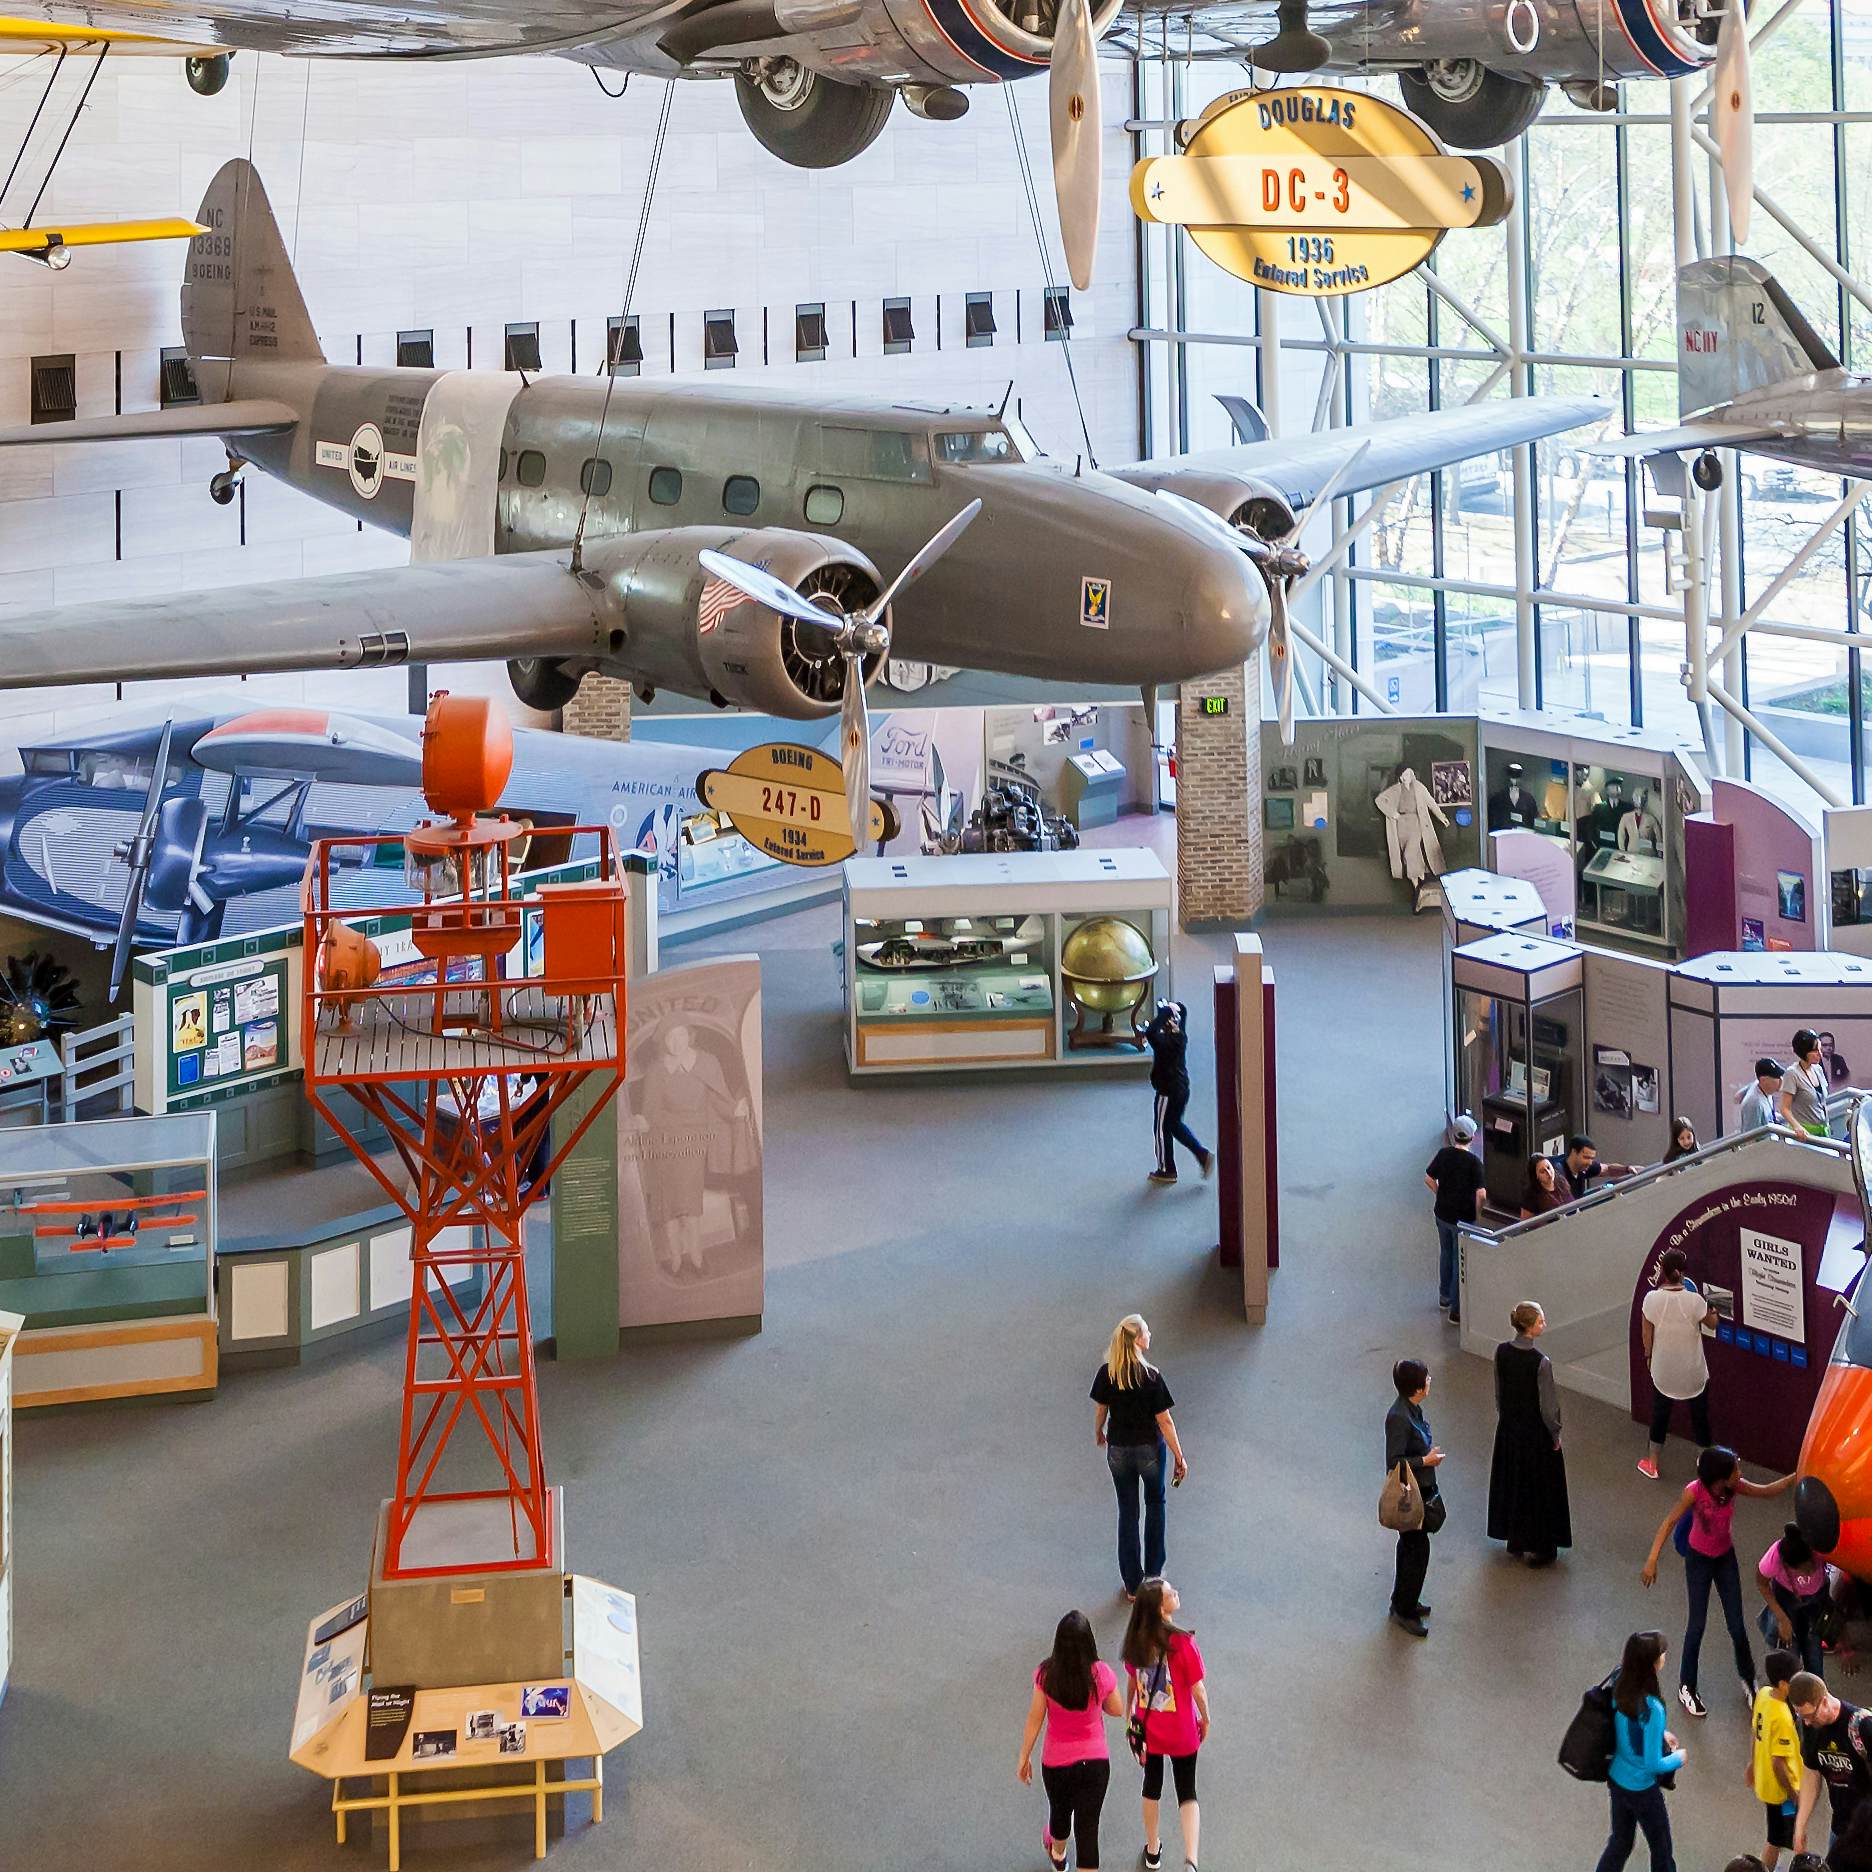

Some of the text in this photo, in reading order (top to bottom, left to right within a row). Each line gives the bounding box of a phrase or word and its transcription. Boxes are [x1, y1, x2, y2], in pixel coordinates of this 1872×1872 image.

[1258, 96, 1357, 131] DOUGLAS
[1261, 167, 1351, 214] DC-3
[206, 208, 224, 228] NC
[1287, 236, 1335, 264] 1936
[192, 264, 231, 280] BOEING
[1254, 256, 1370, 289] Entered Service
[1751, 302, 1766, 325] 12
[1206, 696, 1226, 714] EXIT
[880, 726, 927, 757] Ford
[771, 748, 814, 772] BOEING
[880, 757, 926, 769] TRI-MOTOR
[611, 780, 673, 796] AMERICAN
[761, 786, 822, 822] 247-D
[764, 837, 826, 861] Entered Service
[1753, 1238, 1790, 1257] GIRLS
[1746, 1248, 1797, 1272] WANTED
